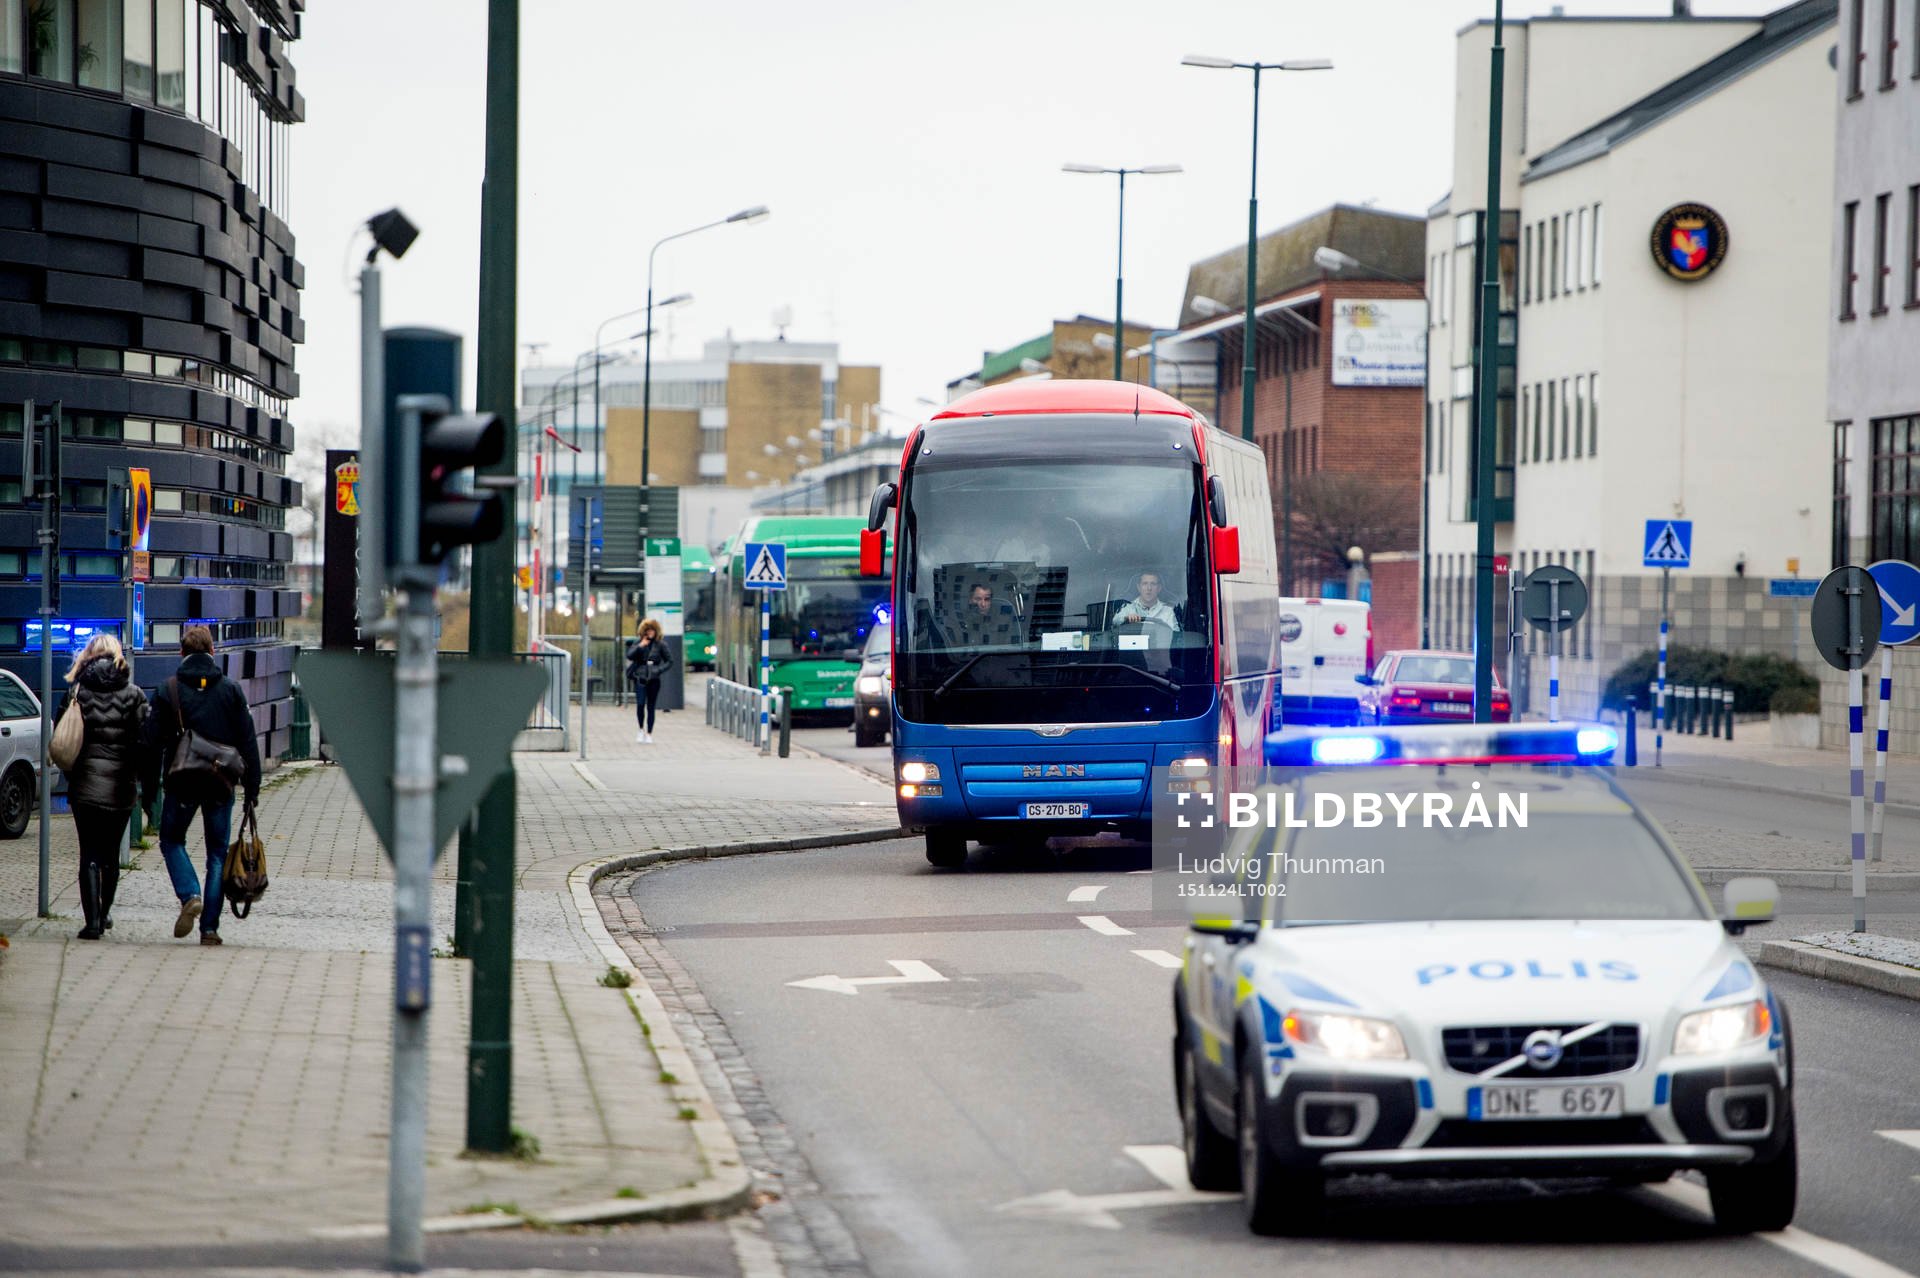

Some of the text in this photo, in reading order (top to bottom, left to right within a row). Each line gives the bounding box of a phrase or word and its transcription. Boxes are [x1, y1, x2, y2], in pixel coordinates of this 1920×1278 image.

[1023, 765, 1084, 777] MAN
[1416, 959, 1639, 985] POLIS
[1487, 1085, 1617, 1114] DNE 667
